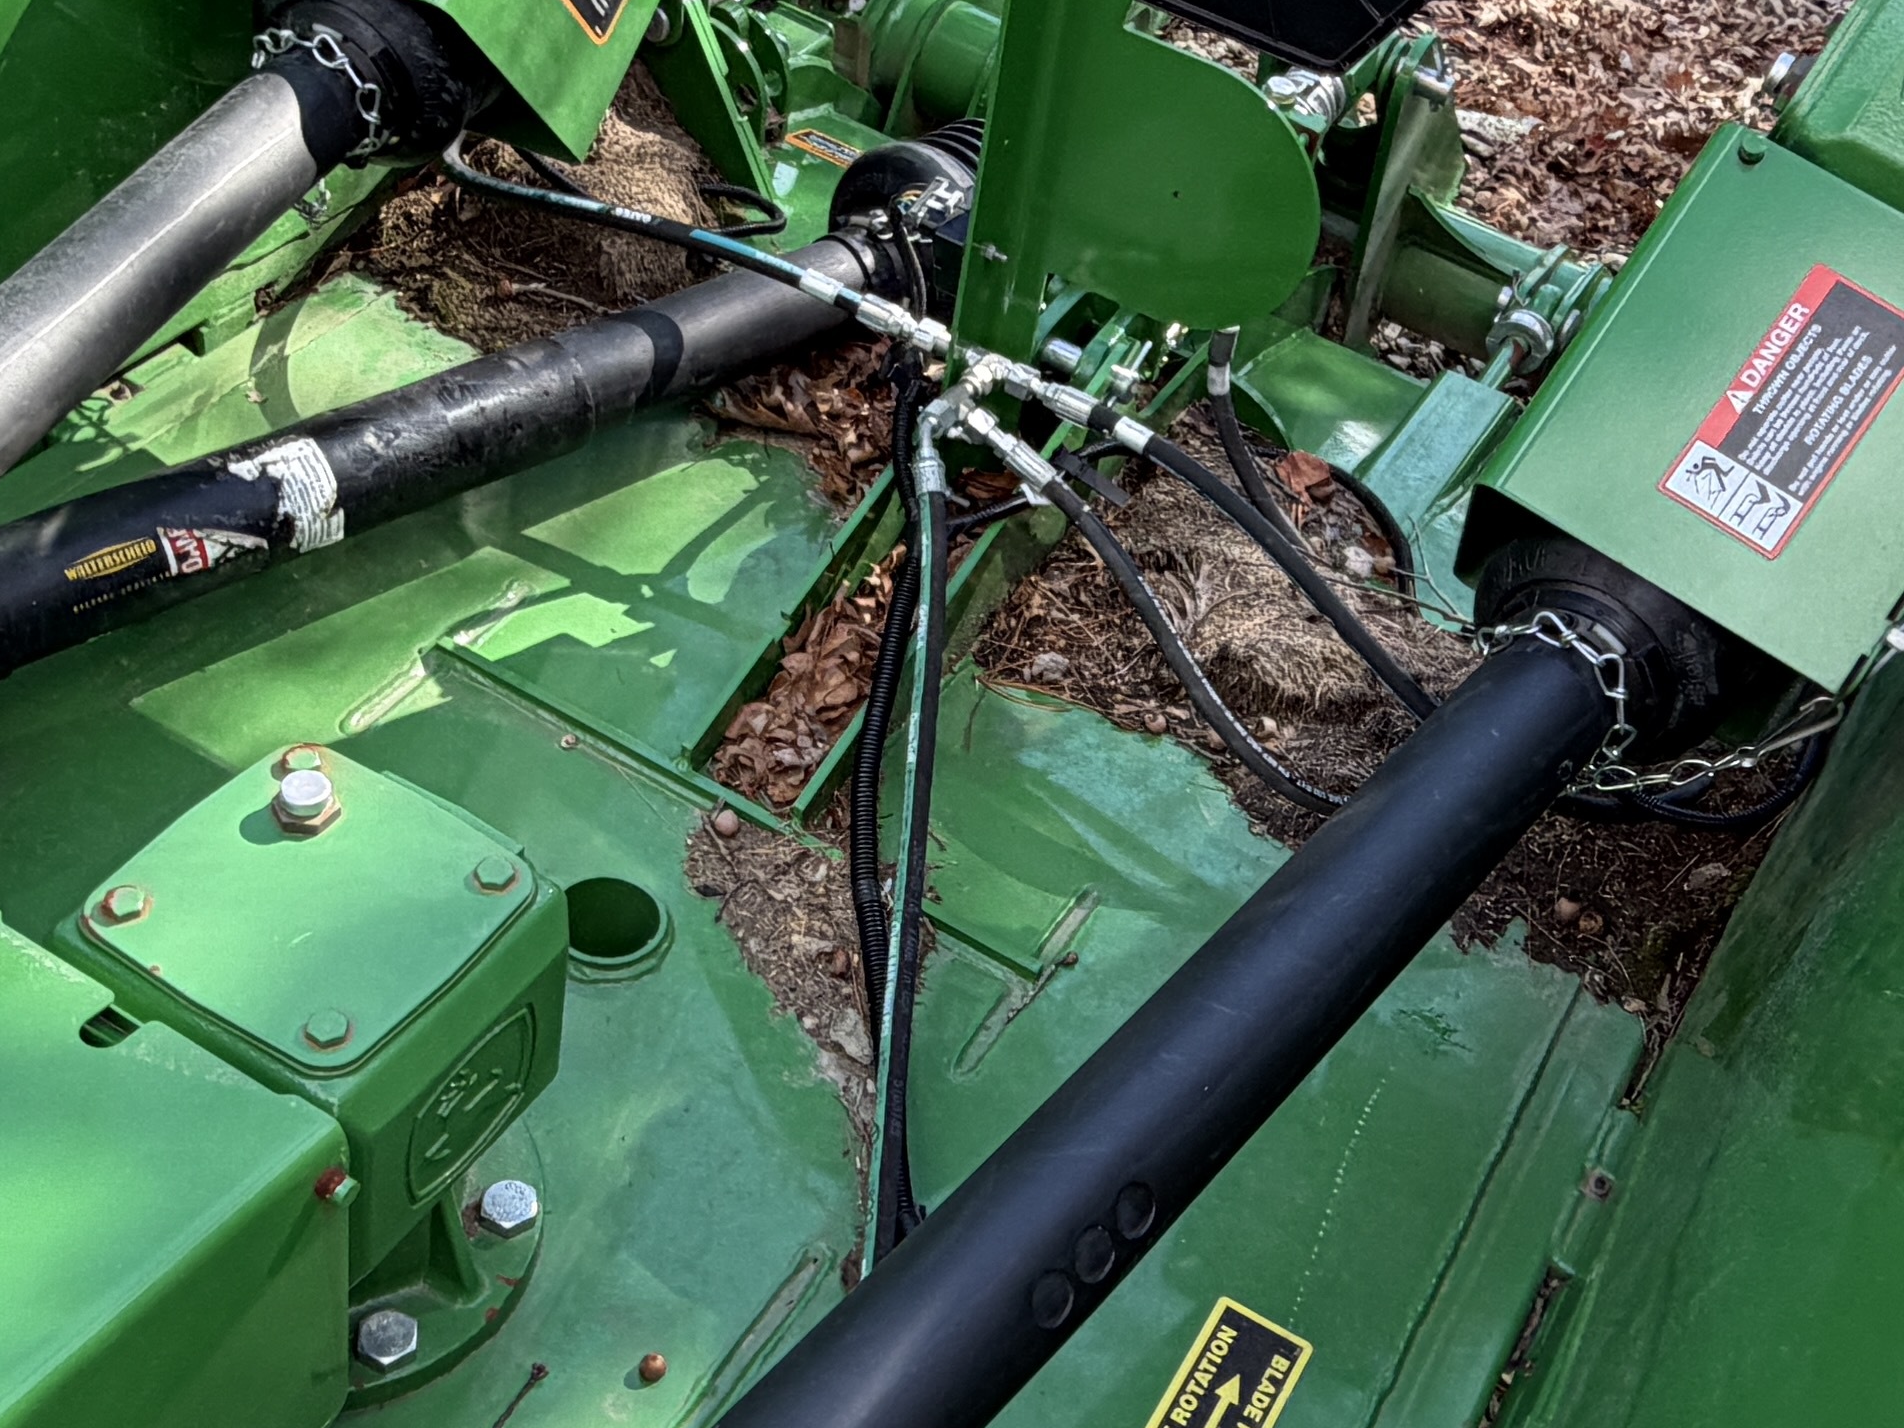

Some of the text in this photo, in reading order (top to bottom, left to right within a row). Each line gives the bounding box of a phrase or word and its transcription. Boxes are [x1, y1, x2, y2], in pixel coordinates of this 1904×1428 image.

[1739, 301, 1809, 388] DANGER
[1169, 1324, 1239, 1427] ROTATION
[1243, 1351, 1292, 1423] BLADE
